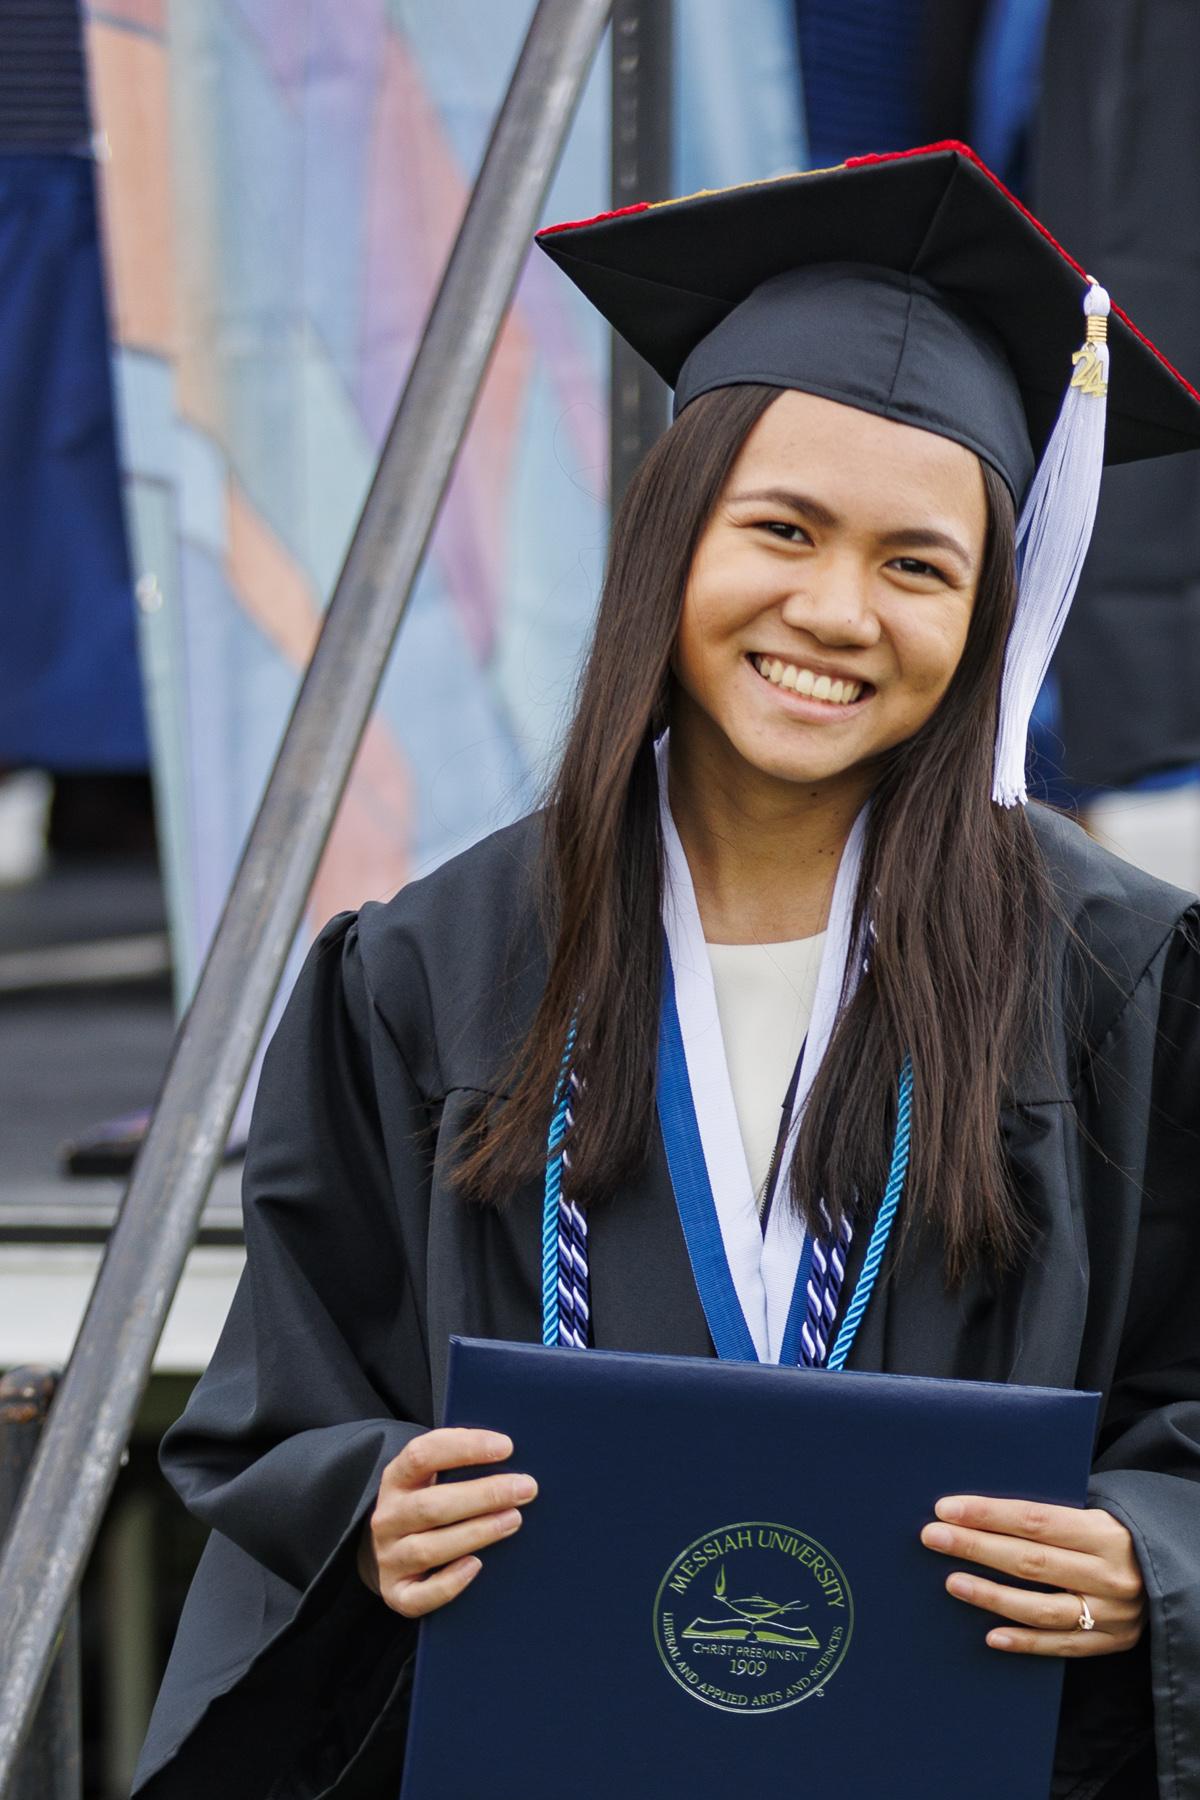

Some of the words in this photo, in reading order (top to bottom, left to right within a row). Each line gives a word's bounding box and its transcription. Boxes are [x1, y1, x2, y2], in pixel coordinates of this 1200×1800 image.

[1071, 351, 1106, 397] 24
[668, 1529, 753, 1595] MESSIAH
[757, 1529, 845, 1608] UNIVERSITY
[663, 1612, 680, 1661] LIBERAL
[676, 1661, 699, 1684] AND
[697, 1682, 748, 1706] APPLIED
[751, 1690, 783, 1706] ARTS
[784, 1676, 811, 1698] AND
[809, 1625, 843, 1680] SCIENCES
[692, 1642, 734, 1656] CHRIST
[736, 1644, 807, 1662] PREEMINENT
[729, 1659, 767, 1676] 1909
